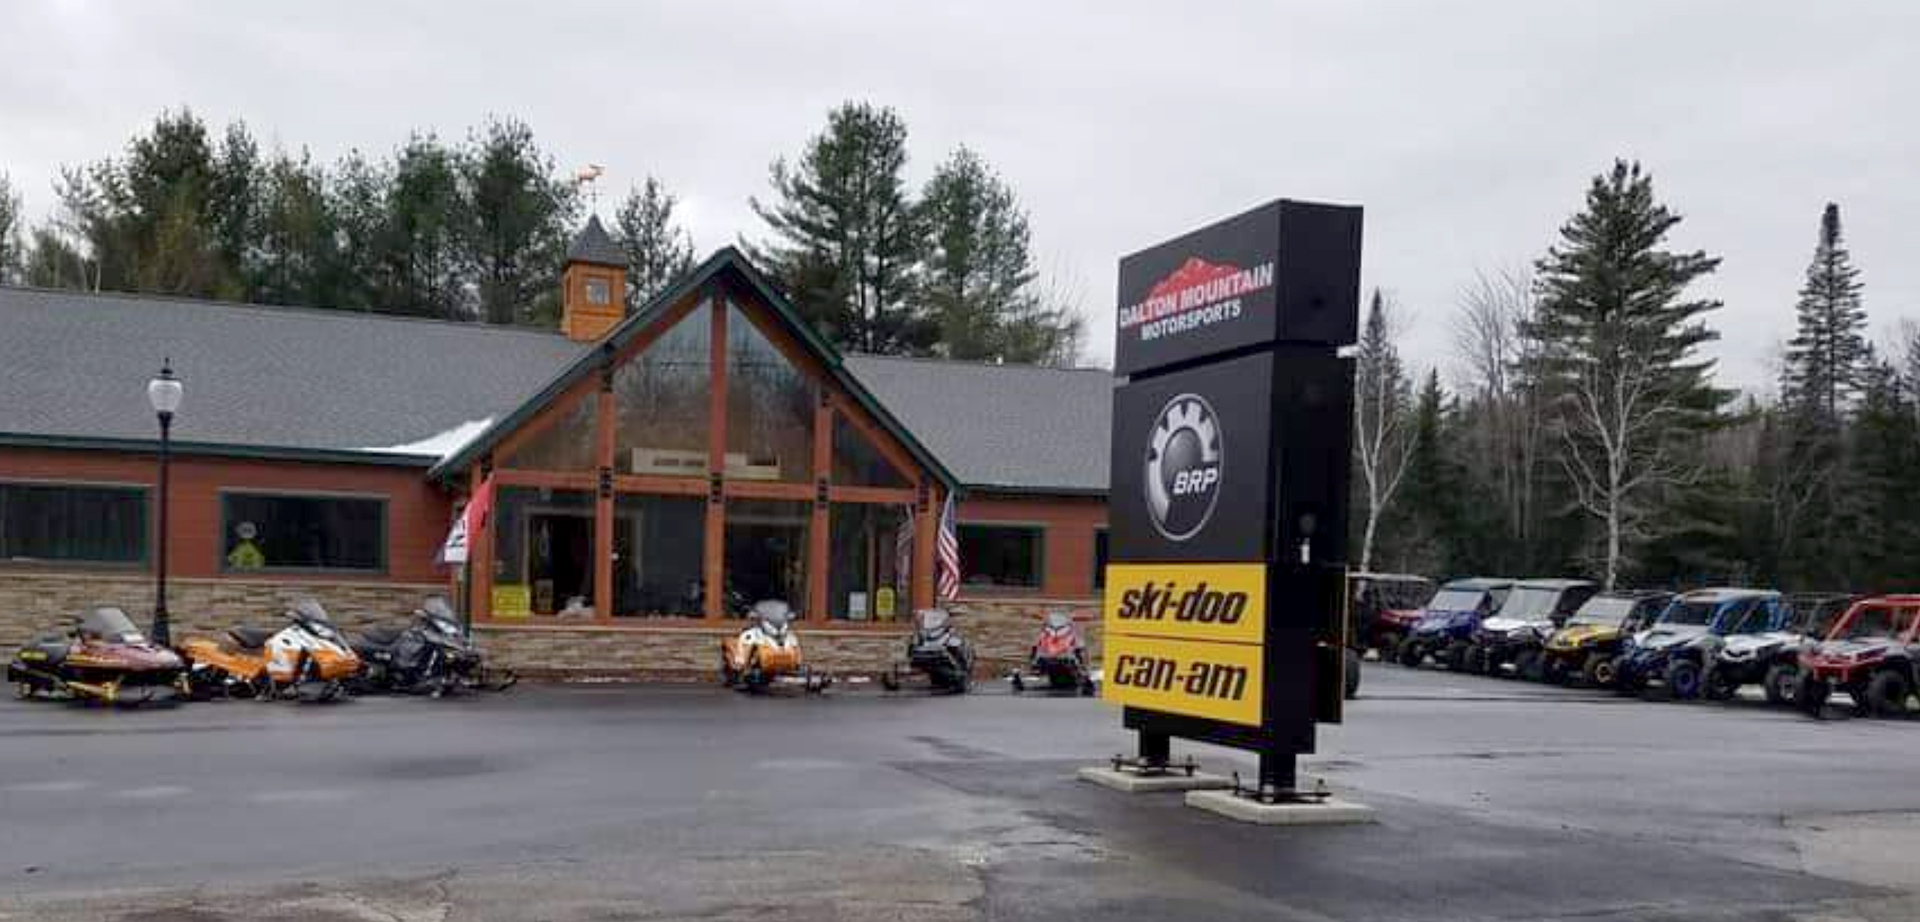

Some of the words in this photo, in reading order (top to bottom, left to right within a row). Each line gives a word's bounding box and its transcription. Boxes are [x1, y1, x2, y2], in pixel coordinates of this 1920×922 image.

[1120, 292, 1177, 327] DALTON
[1180, 262, 1273, 309] MOUNTAIN
[1141, 300, 1241, 340] MOTORSPORTS
[1173, 467, 1218, 494] BRP
[1118, 581, 1248, 624] ski-doo
[1114, 655, 1248, 700] can-am
